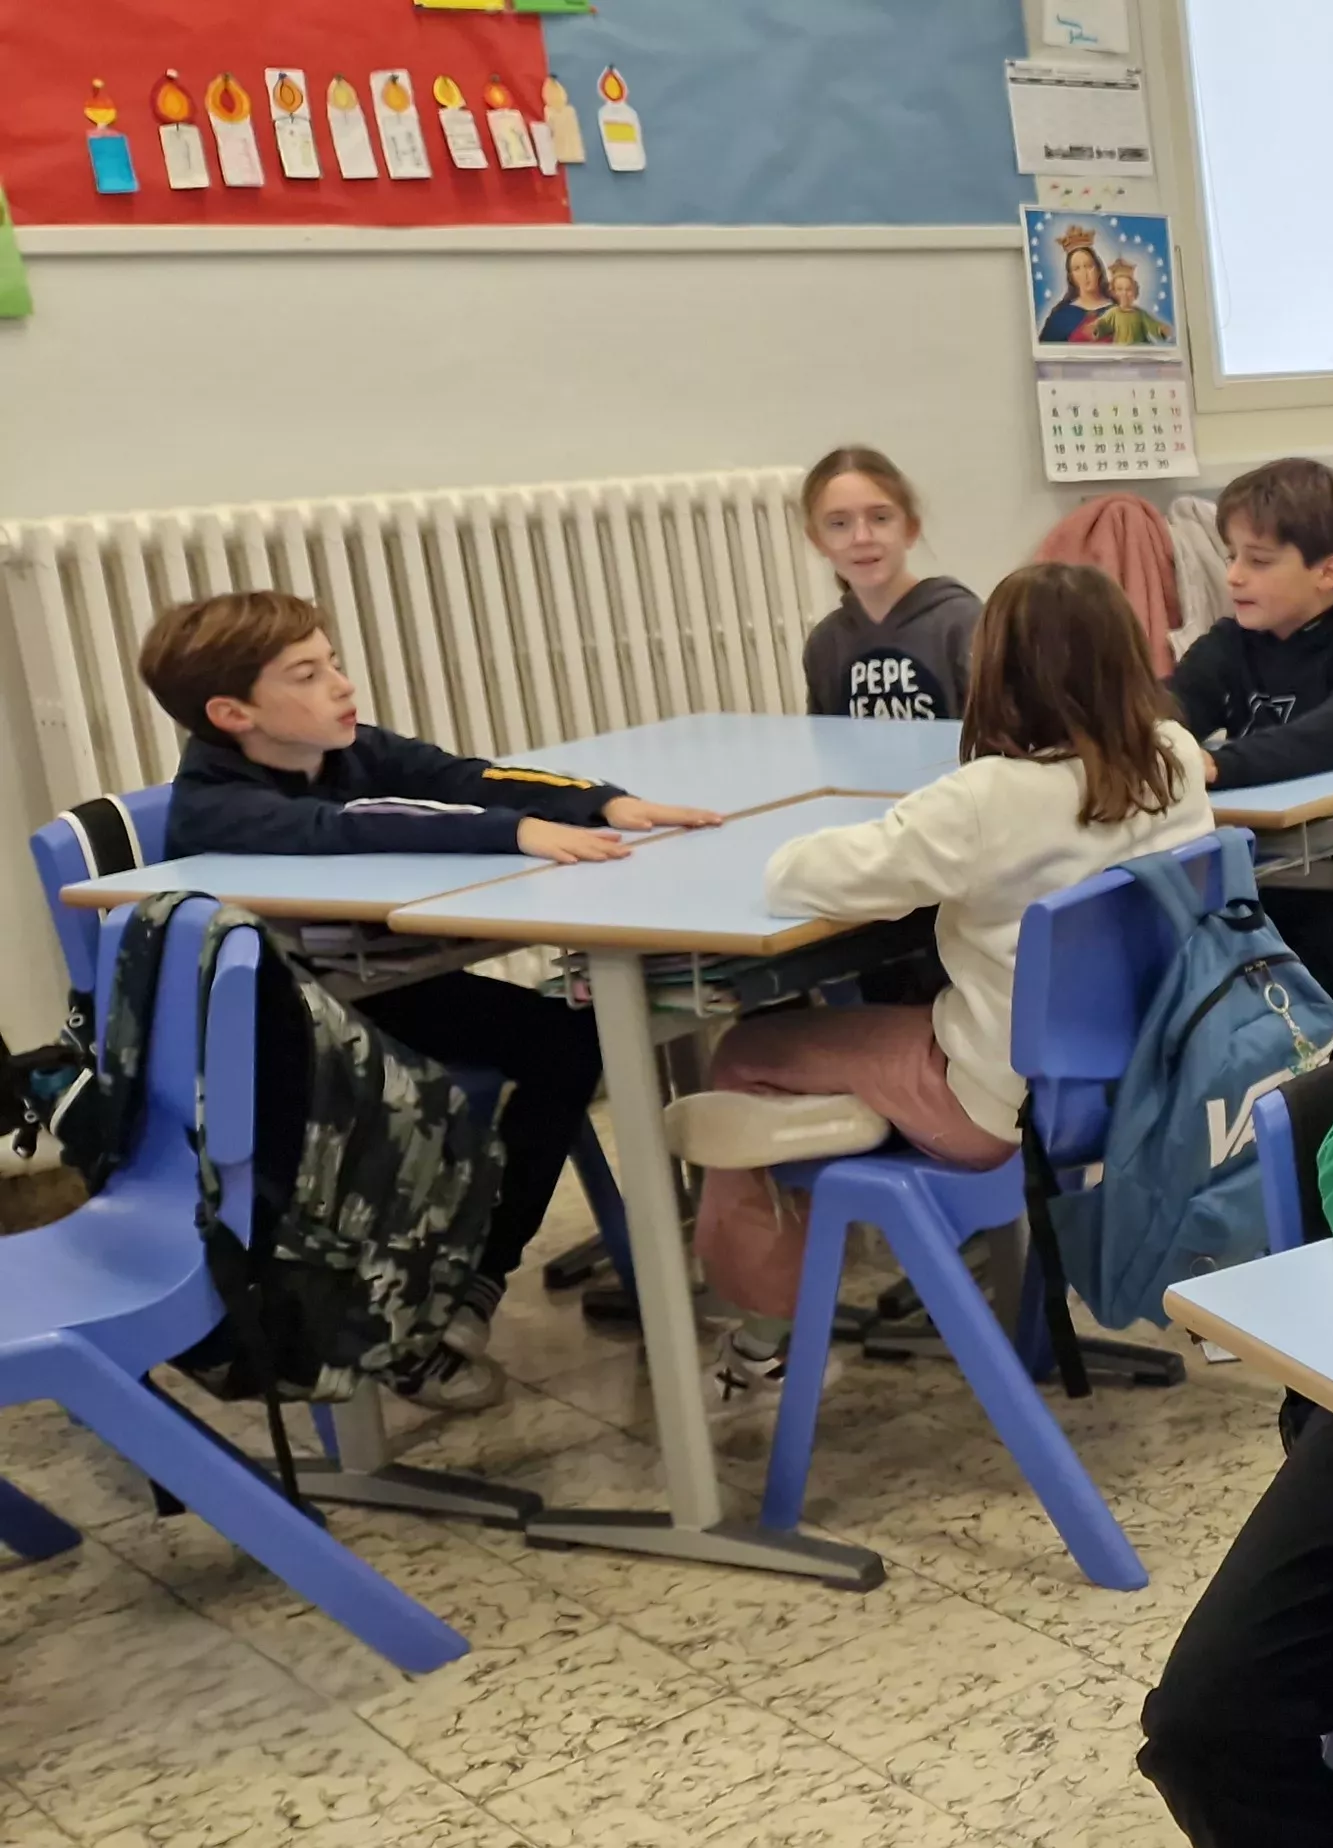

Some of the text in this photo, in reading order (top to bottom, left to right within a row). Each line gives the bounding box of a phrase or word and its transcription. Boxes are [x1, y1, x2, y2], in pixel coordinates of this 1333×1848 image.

[1095, 443, 1106, 453] 20
[1115, 443, 1125, 453] 21
[1135, 442, 1146, 453] 22
[1154, 442, 1166, 452] 23
[851, 657, 918, 696] PEPE
